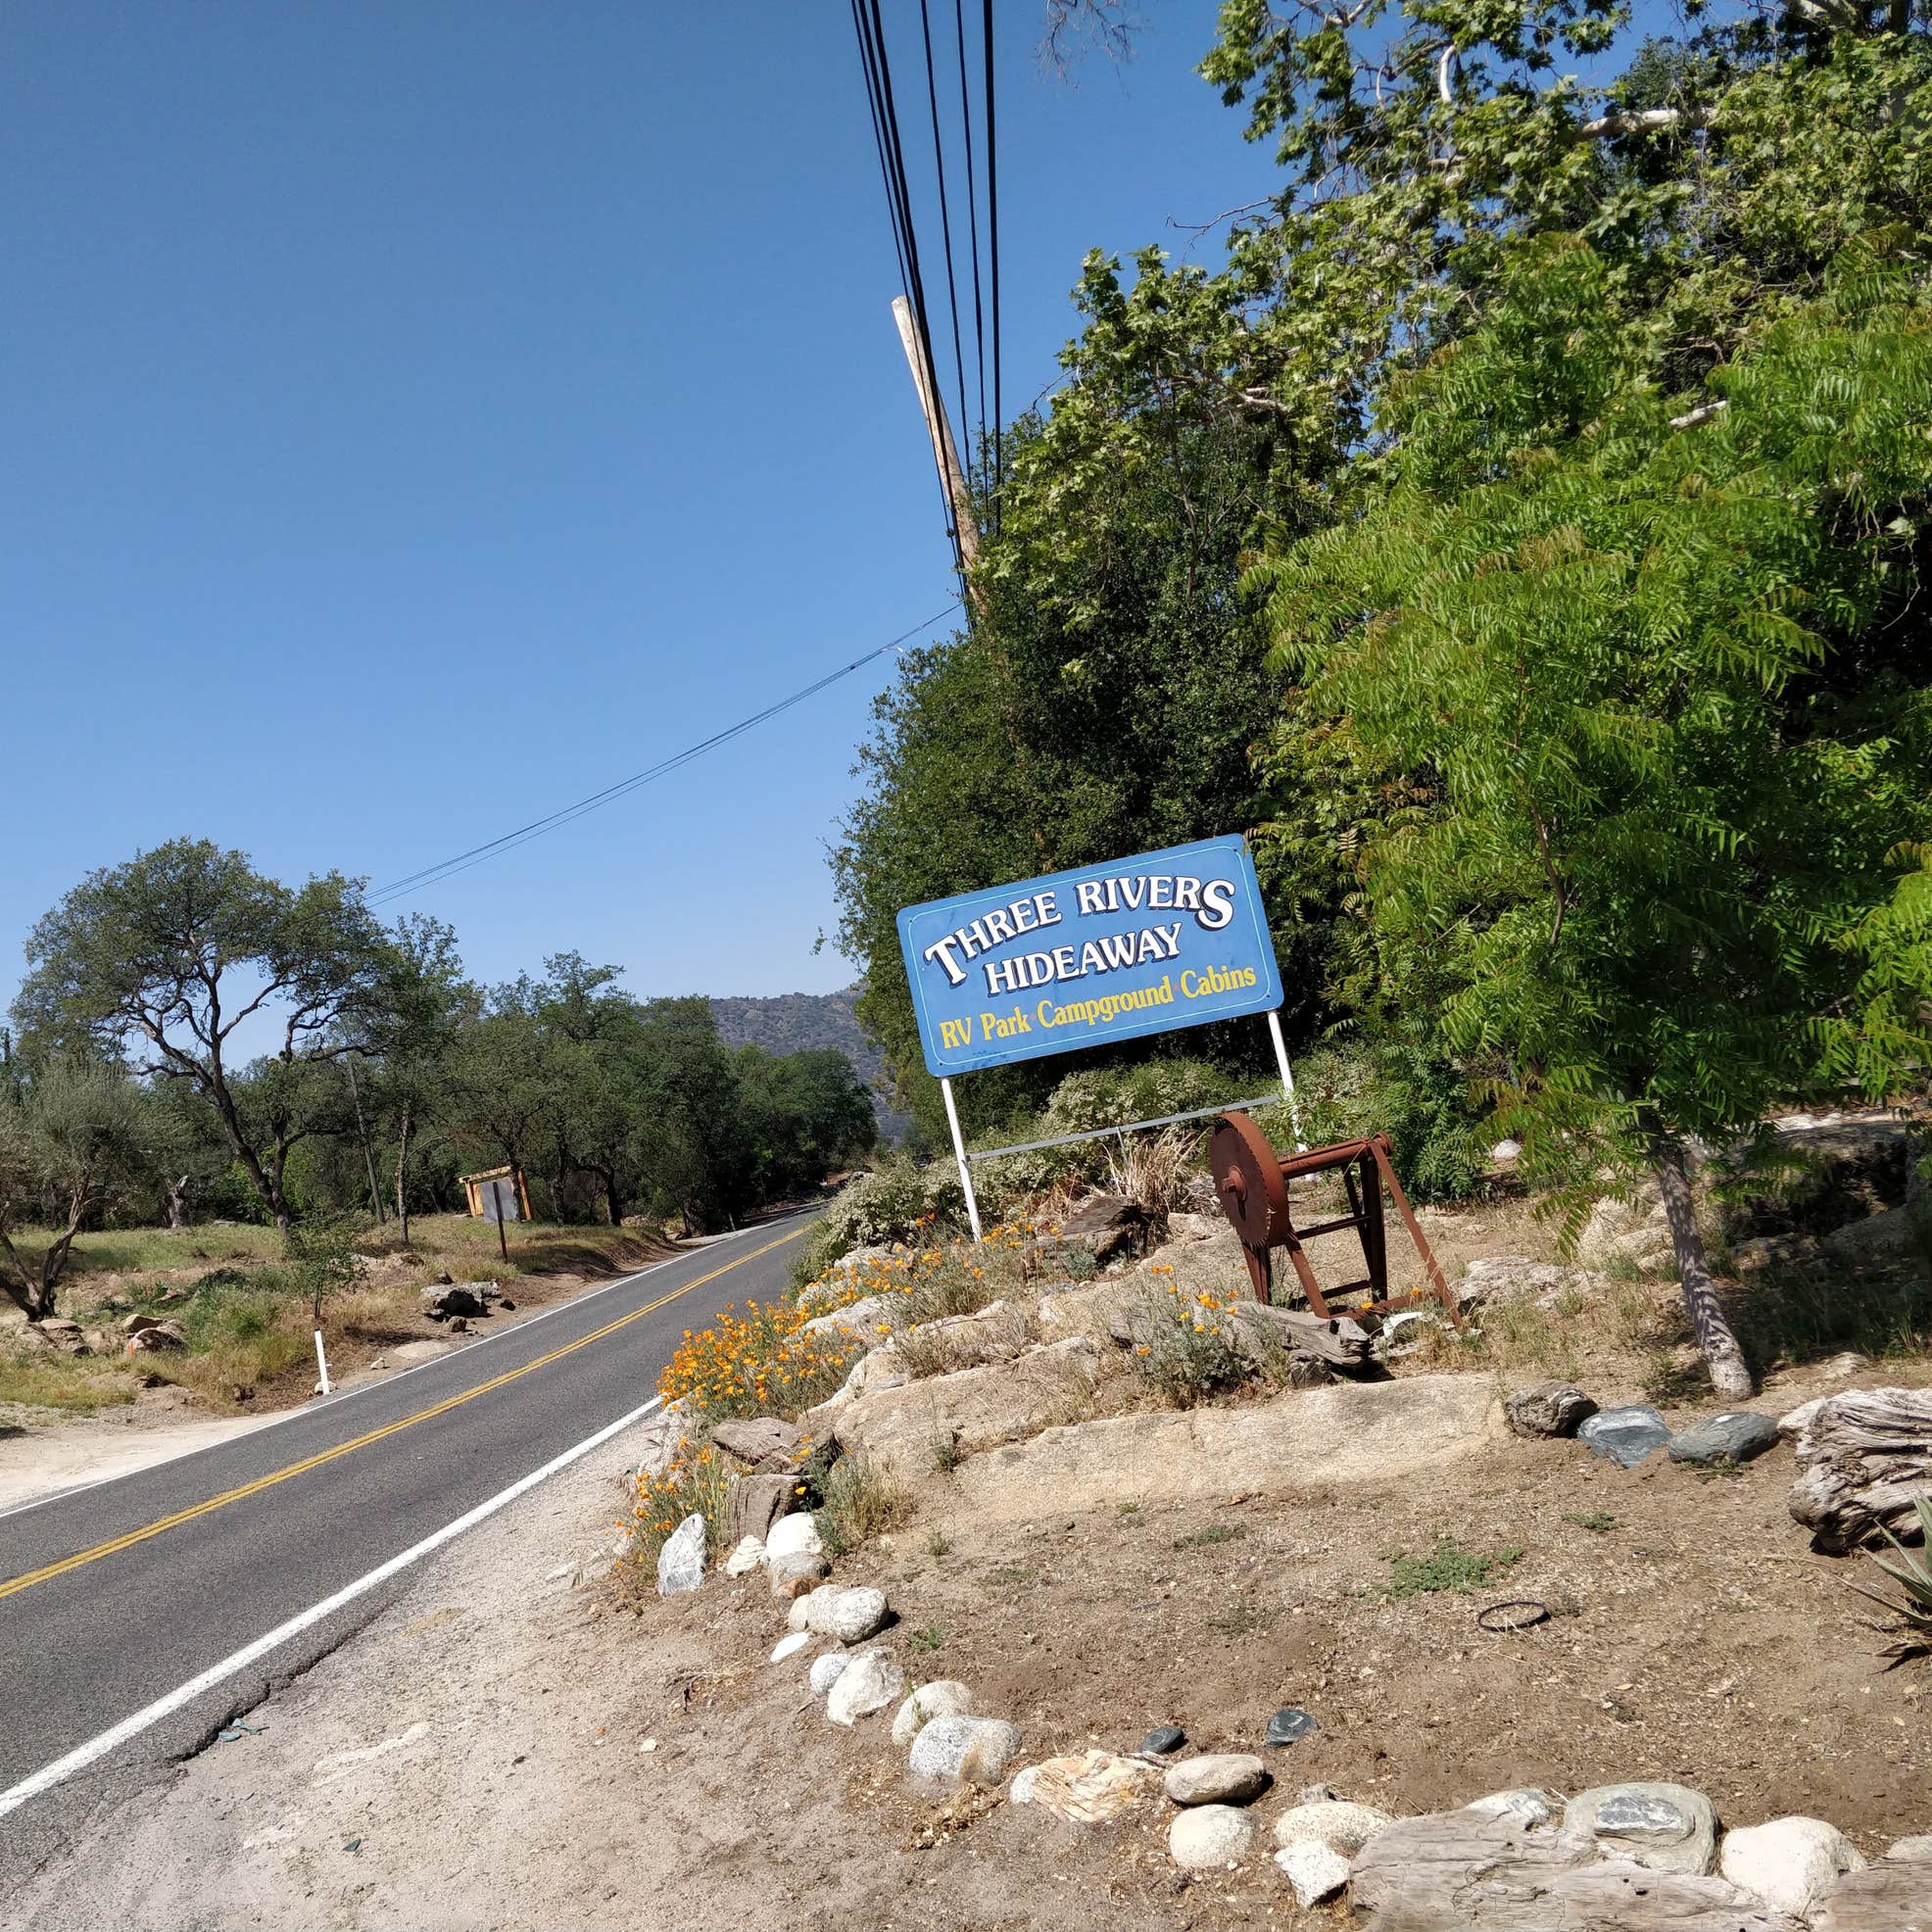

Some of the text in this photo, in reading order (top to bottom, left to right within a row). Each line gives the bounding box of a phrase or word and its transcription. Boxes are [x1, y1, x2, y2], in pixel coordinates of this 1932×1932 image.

[924, 875, 1236, 988] THREE RIVERS
[984, 922, 1183, 998] HIDEAWAY
[940, 965, 1257, 1049] RV Park Campground Cabins
